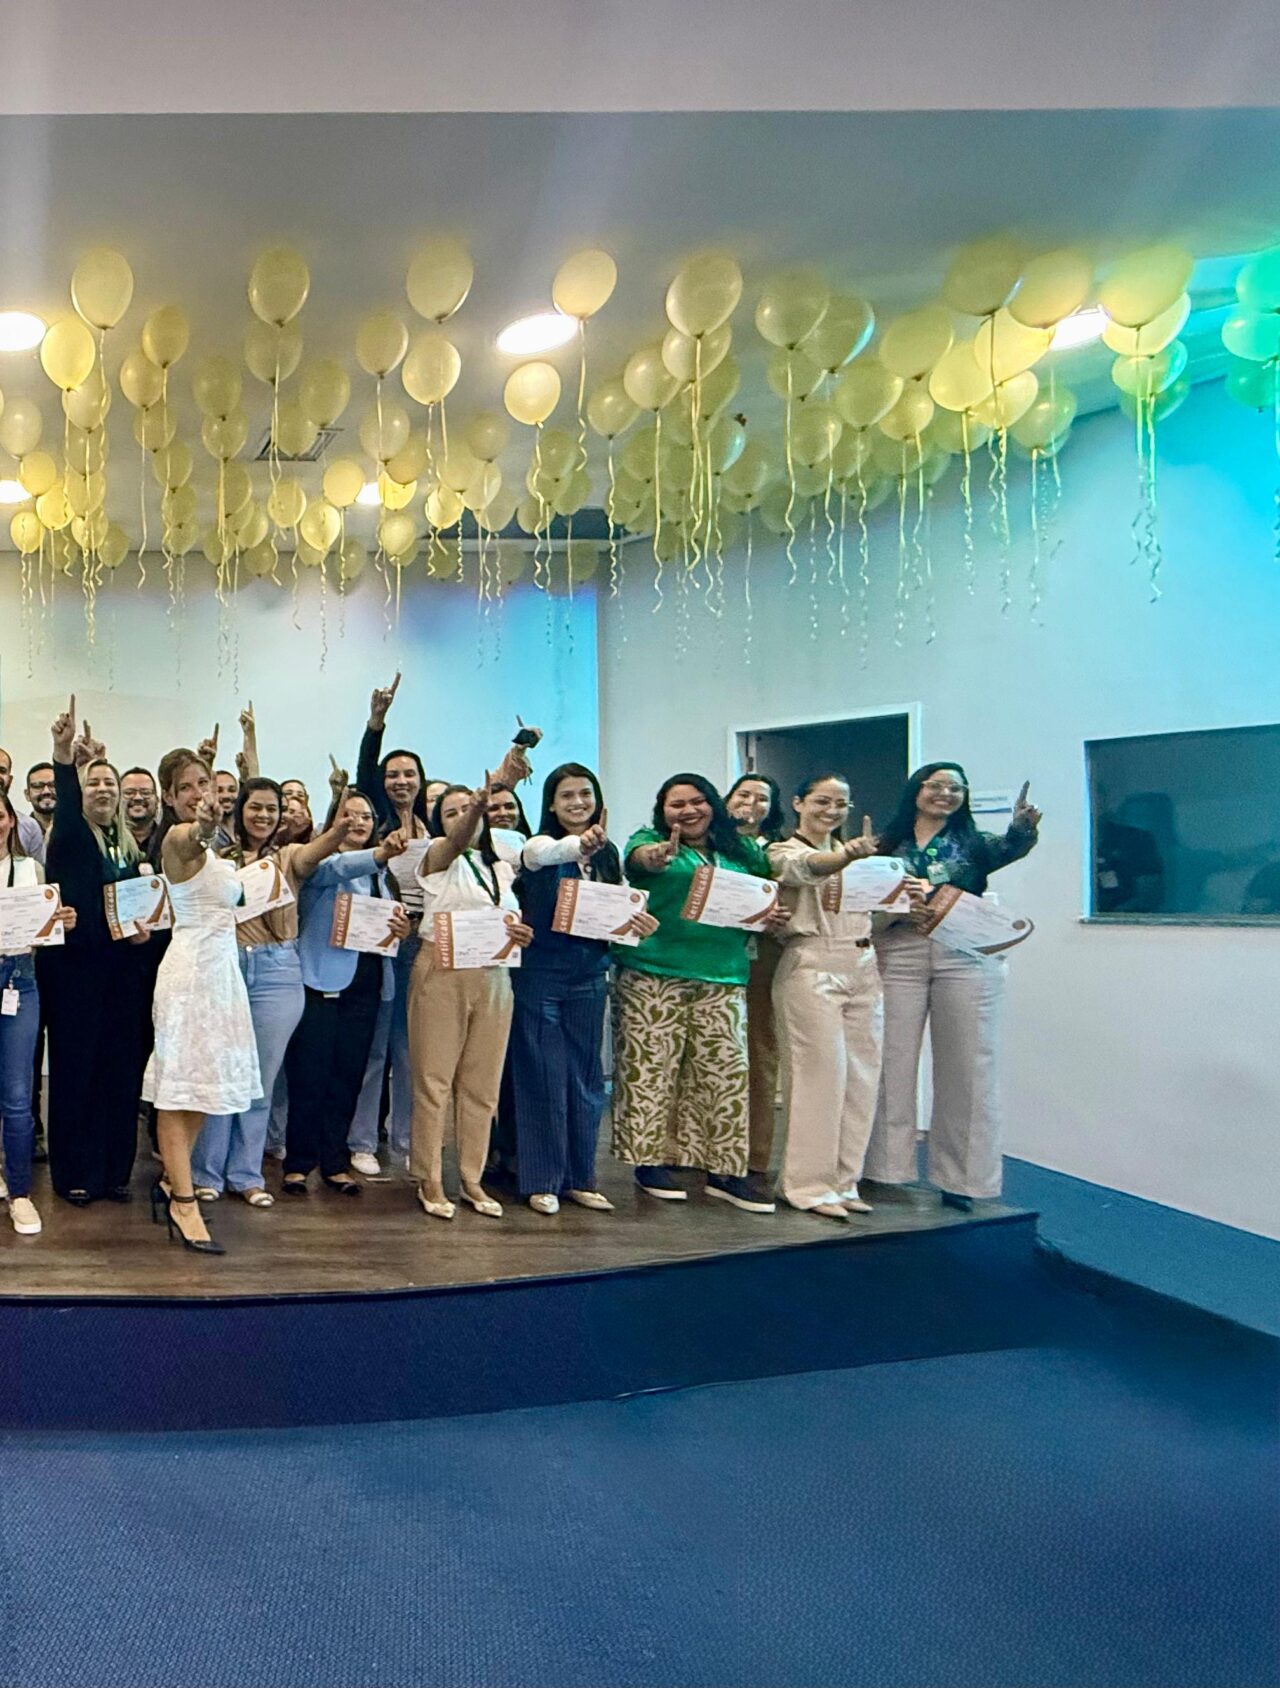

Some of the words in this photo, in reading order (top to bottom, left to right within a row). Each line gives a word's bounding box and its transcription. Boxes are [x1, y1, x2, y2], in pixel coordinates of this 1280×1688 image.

[560, 880, 574, 932] certificado
[687, 867, 708, 919] certificado
[439, 913, 450, 968] certificado
